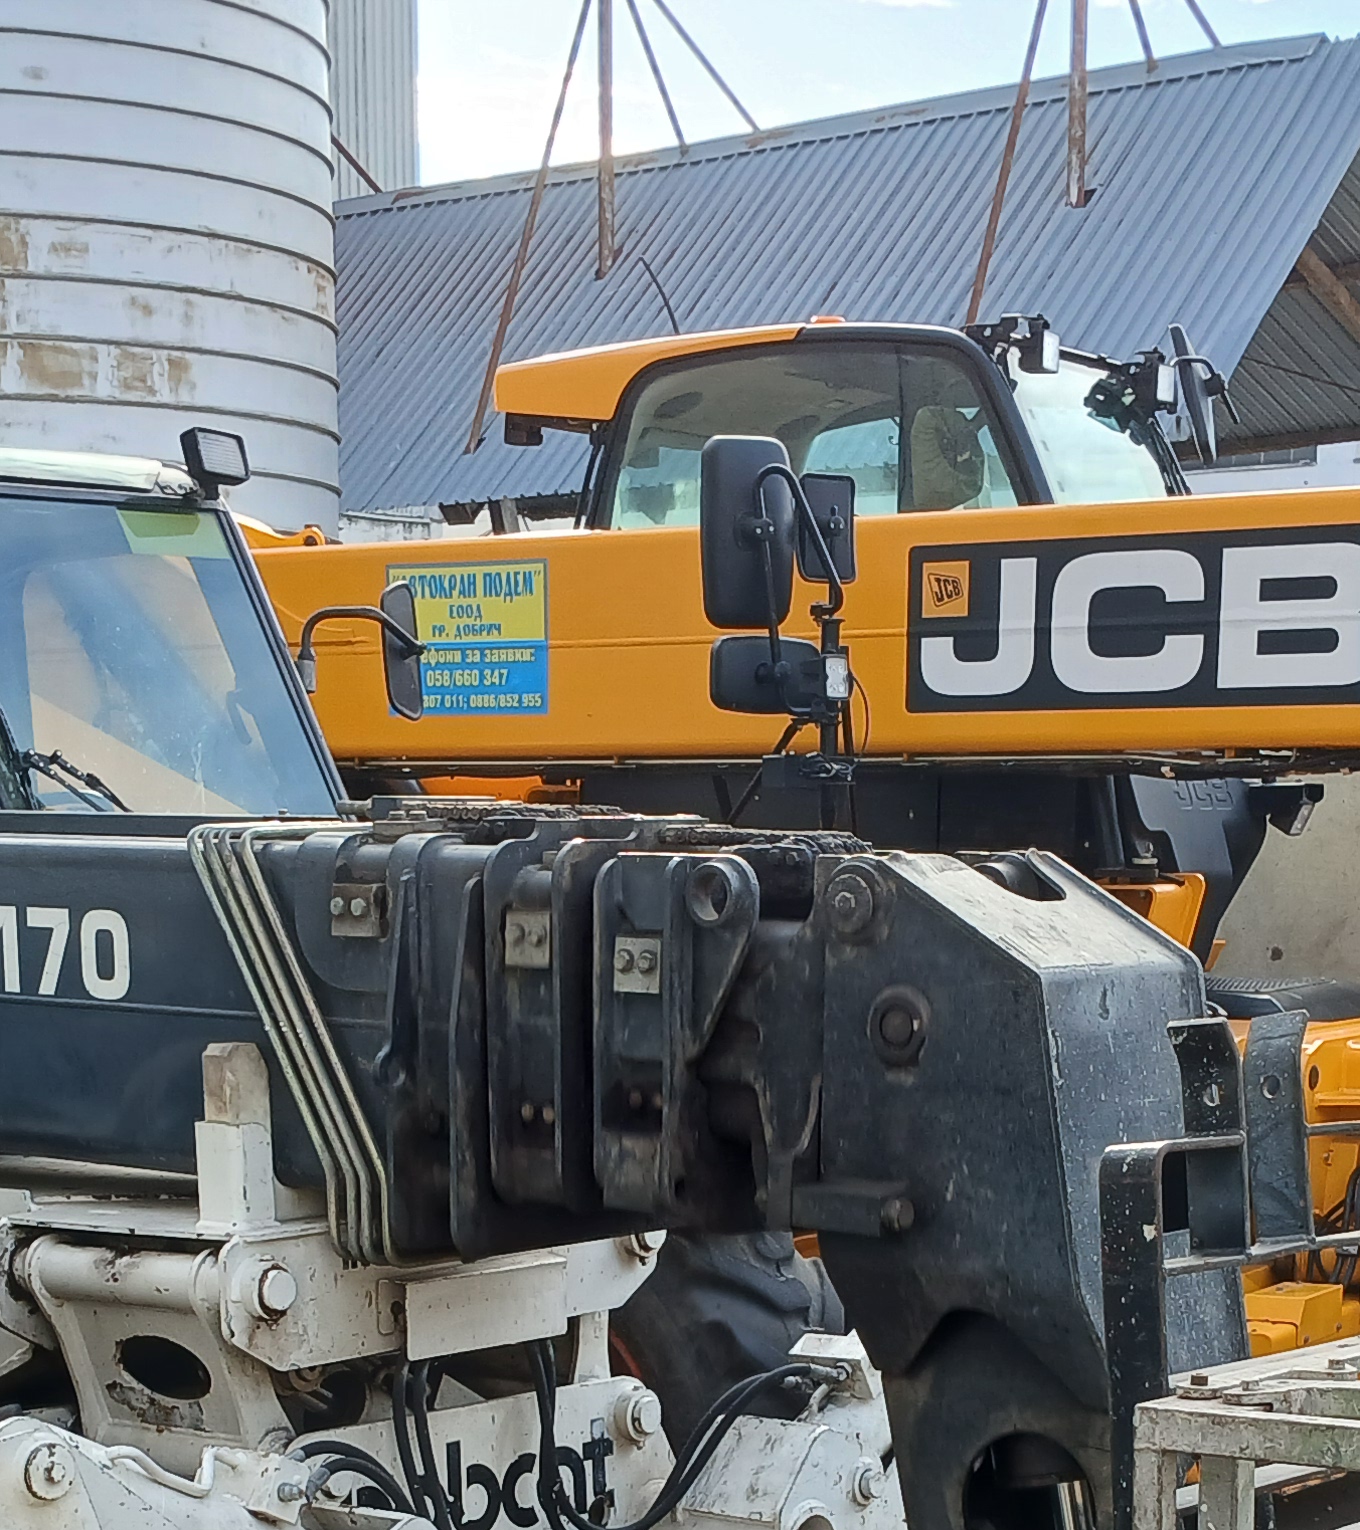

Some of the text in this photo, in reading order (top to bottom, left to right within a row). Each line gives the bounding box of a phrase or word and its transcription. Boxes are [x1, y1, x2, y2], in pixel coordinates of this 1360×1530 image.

[933, 577, 961, 603] JCB
[449, 604, 483, 621] ЕООД
[431, 623, 502, 640] ГР. ДОБРИЧ
[421, 649, 461, 667] ефони
[465, 649, 481, 663] за
[426, 668, 508, 689] 058/660 347
[522, 692, 542, 707] 955
[1173, 779, 1234, 811] JCB
